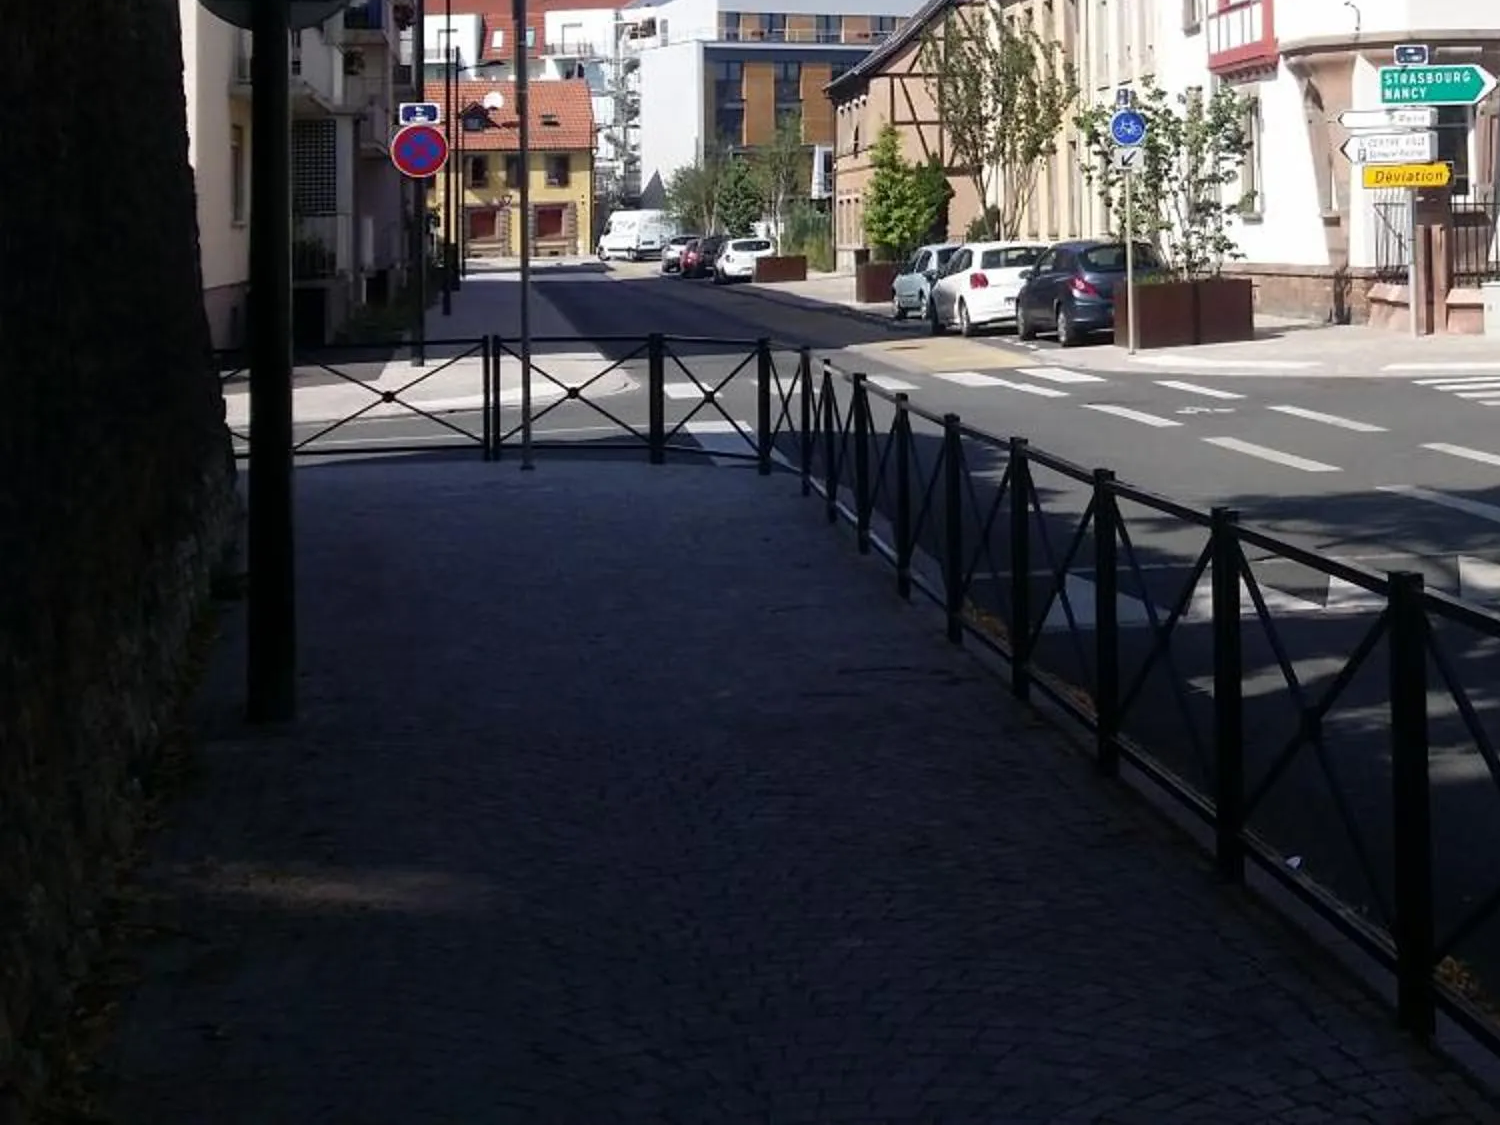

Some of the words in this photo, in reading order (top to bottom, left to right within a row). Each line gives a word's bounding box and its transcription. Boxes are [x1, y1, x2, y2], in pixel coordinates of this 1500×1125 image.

[1383, 70, 1471, 85] STRASBOURG
[1384, 86, 1427, 100] NANCY
[1375, 169, 1443, 184] Déviation
